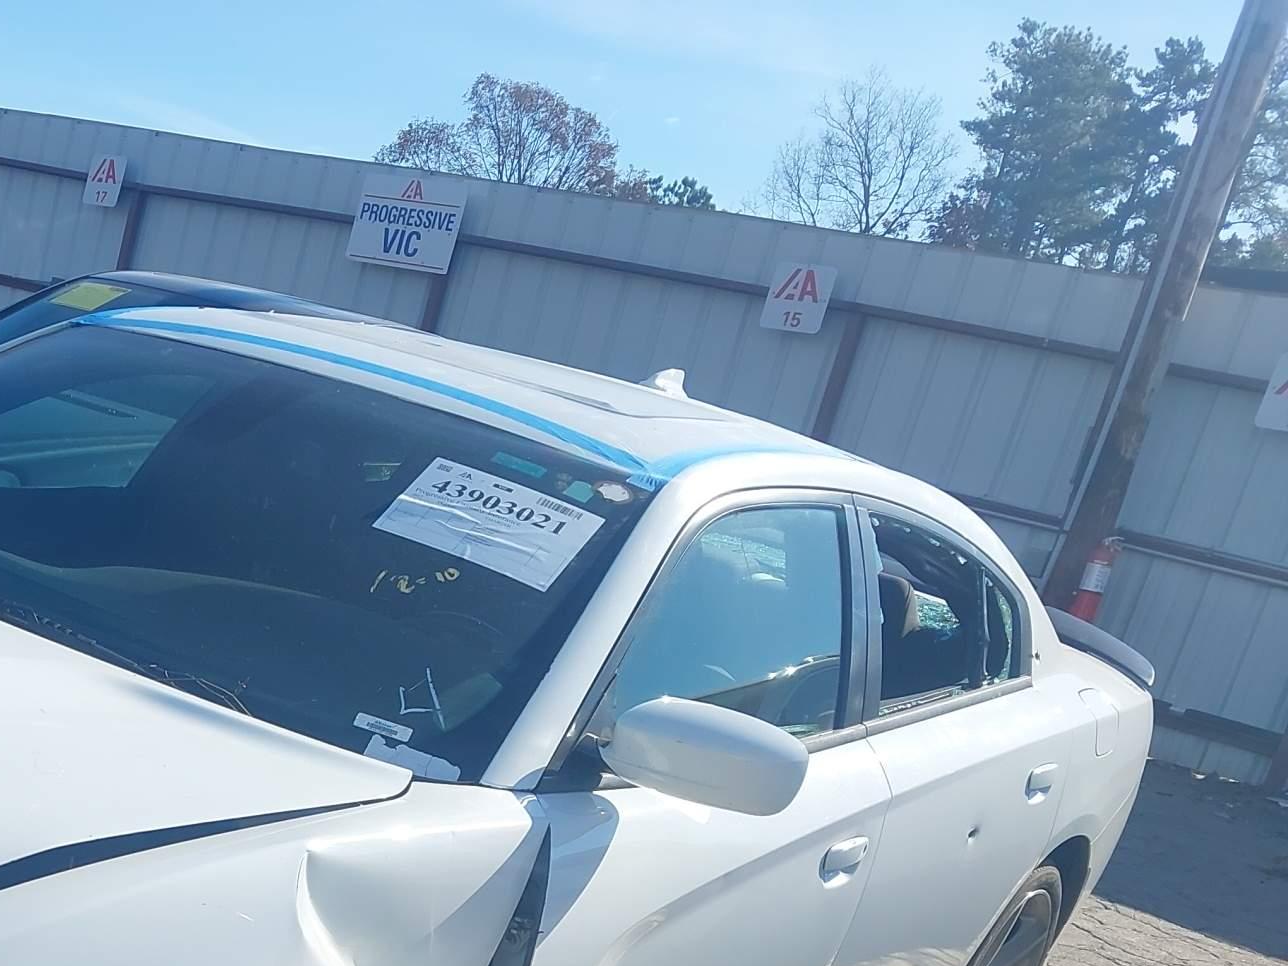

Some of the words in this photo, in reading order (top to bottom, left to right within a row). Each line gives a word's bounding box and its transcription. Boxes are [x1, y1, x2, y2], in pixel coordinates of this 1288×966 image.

[95, 190, 108, 203] 17
[359, 202, 457, 232] PROGRESSIVE
[382, 227, 421, 258] VIC
[783, 311, 803, 328] 15
[431, 480, 567, 535] 43903021
